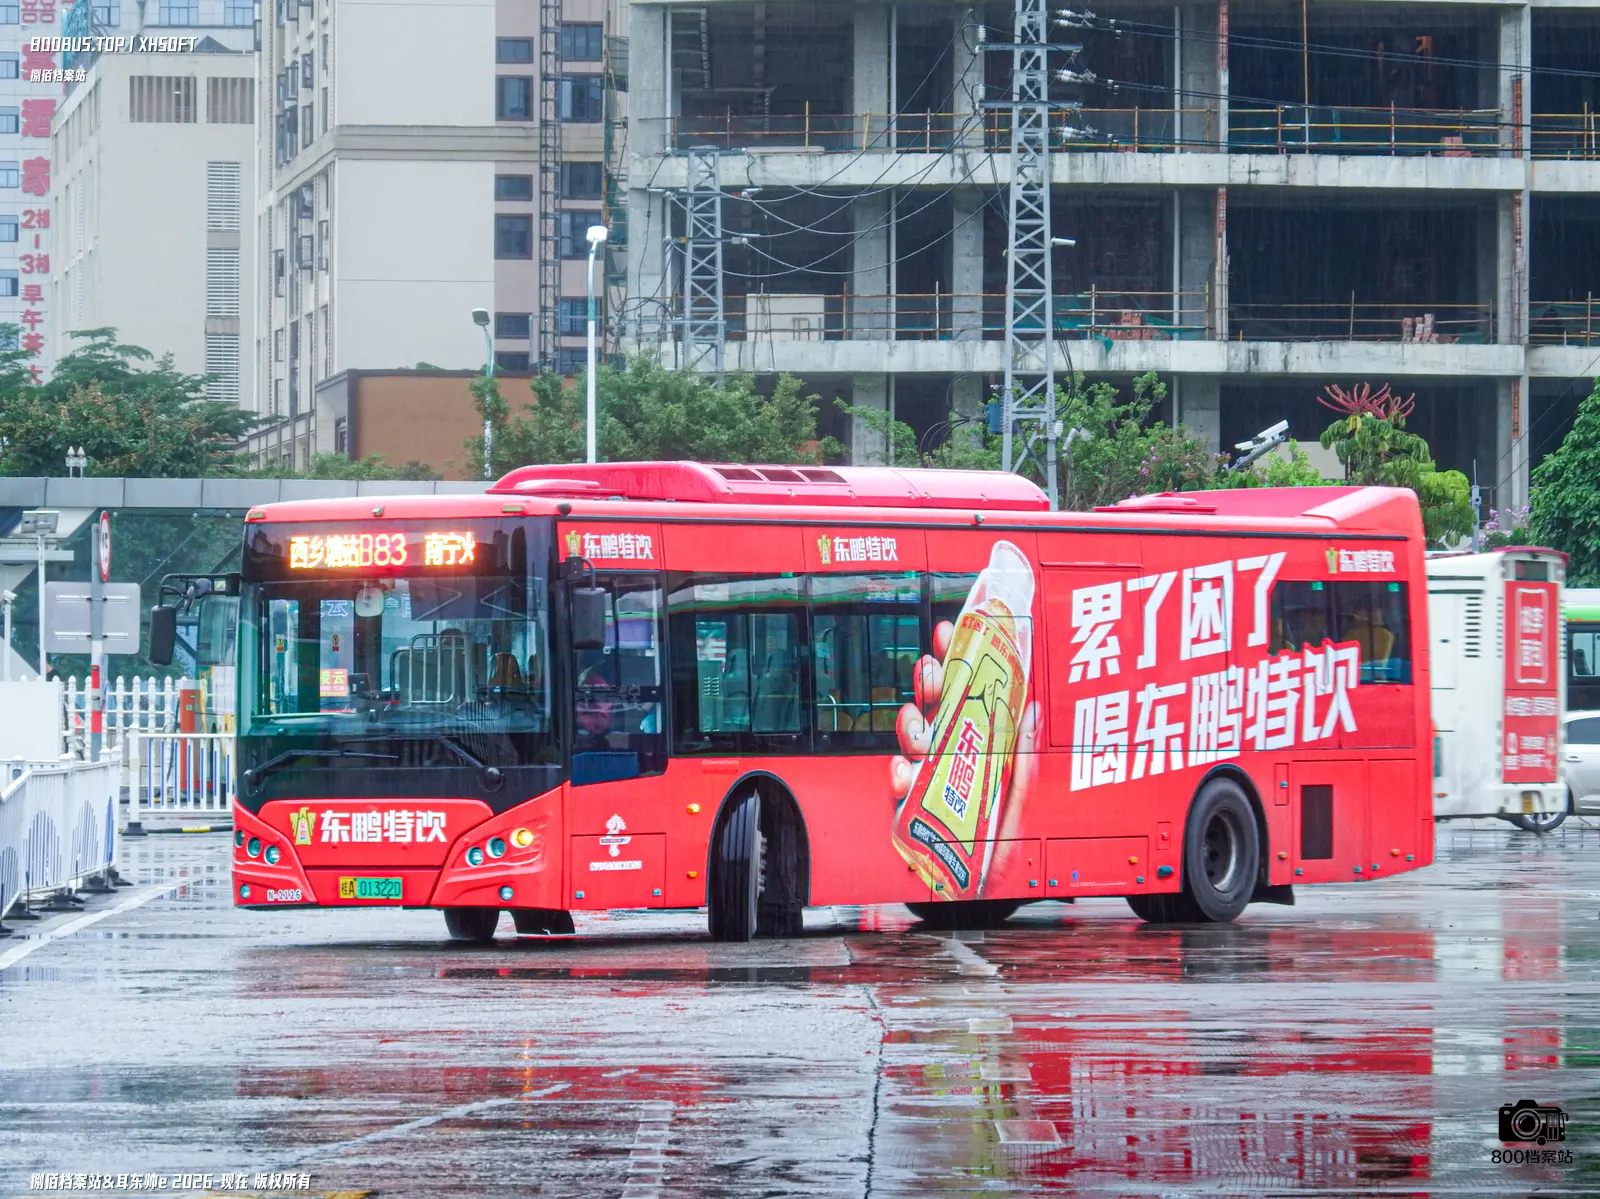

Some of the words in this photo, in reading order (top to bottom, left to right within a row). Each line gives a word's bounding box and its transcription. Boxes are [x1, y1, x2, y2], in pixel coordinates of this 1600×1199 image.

[359, 533, 408, 567] B83
[583, 532, 654, 560] 东鹏特饮
[833, 536, 898, 562] 东鹏特饮
[1067, 551, 1288, 684] 累了困了
[1070, 645, 1360, 792] 喝东鹏特饮
[320, 809, 448, 843] 东鹏特饮
